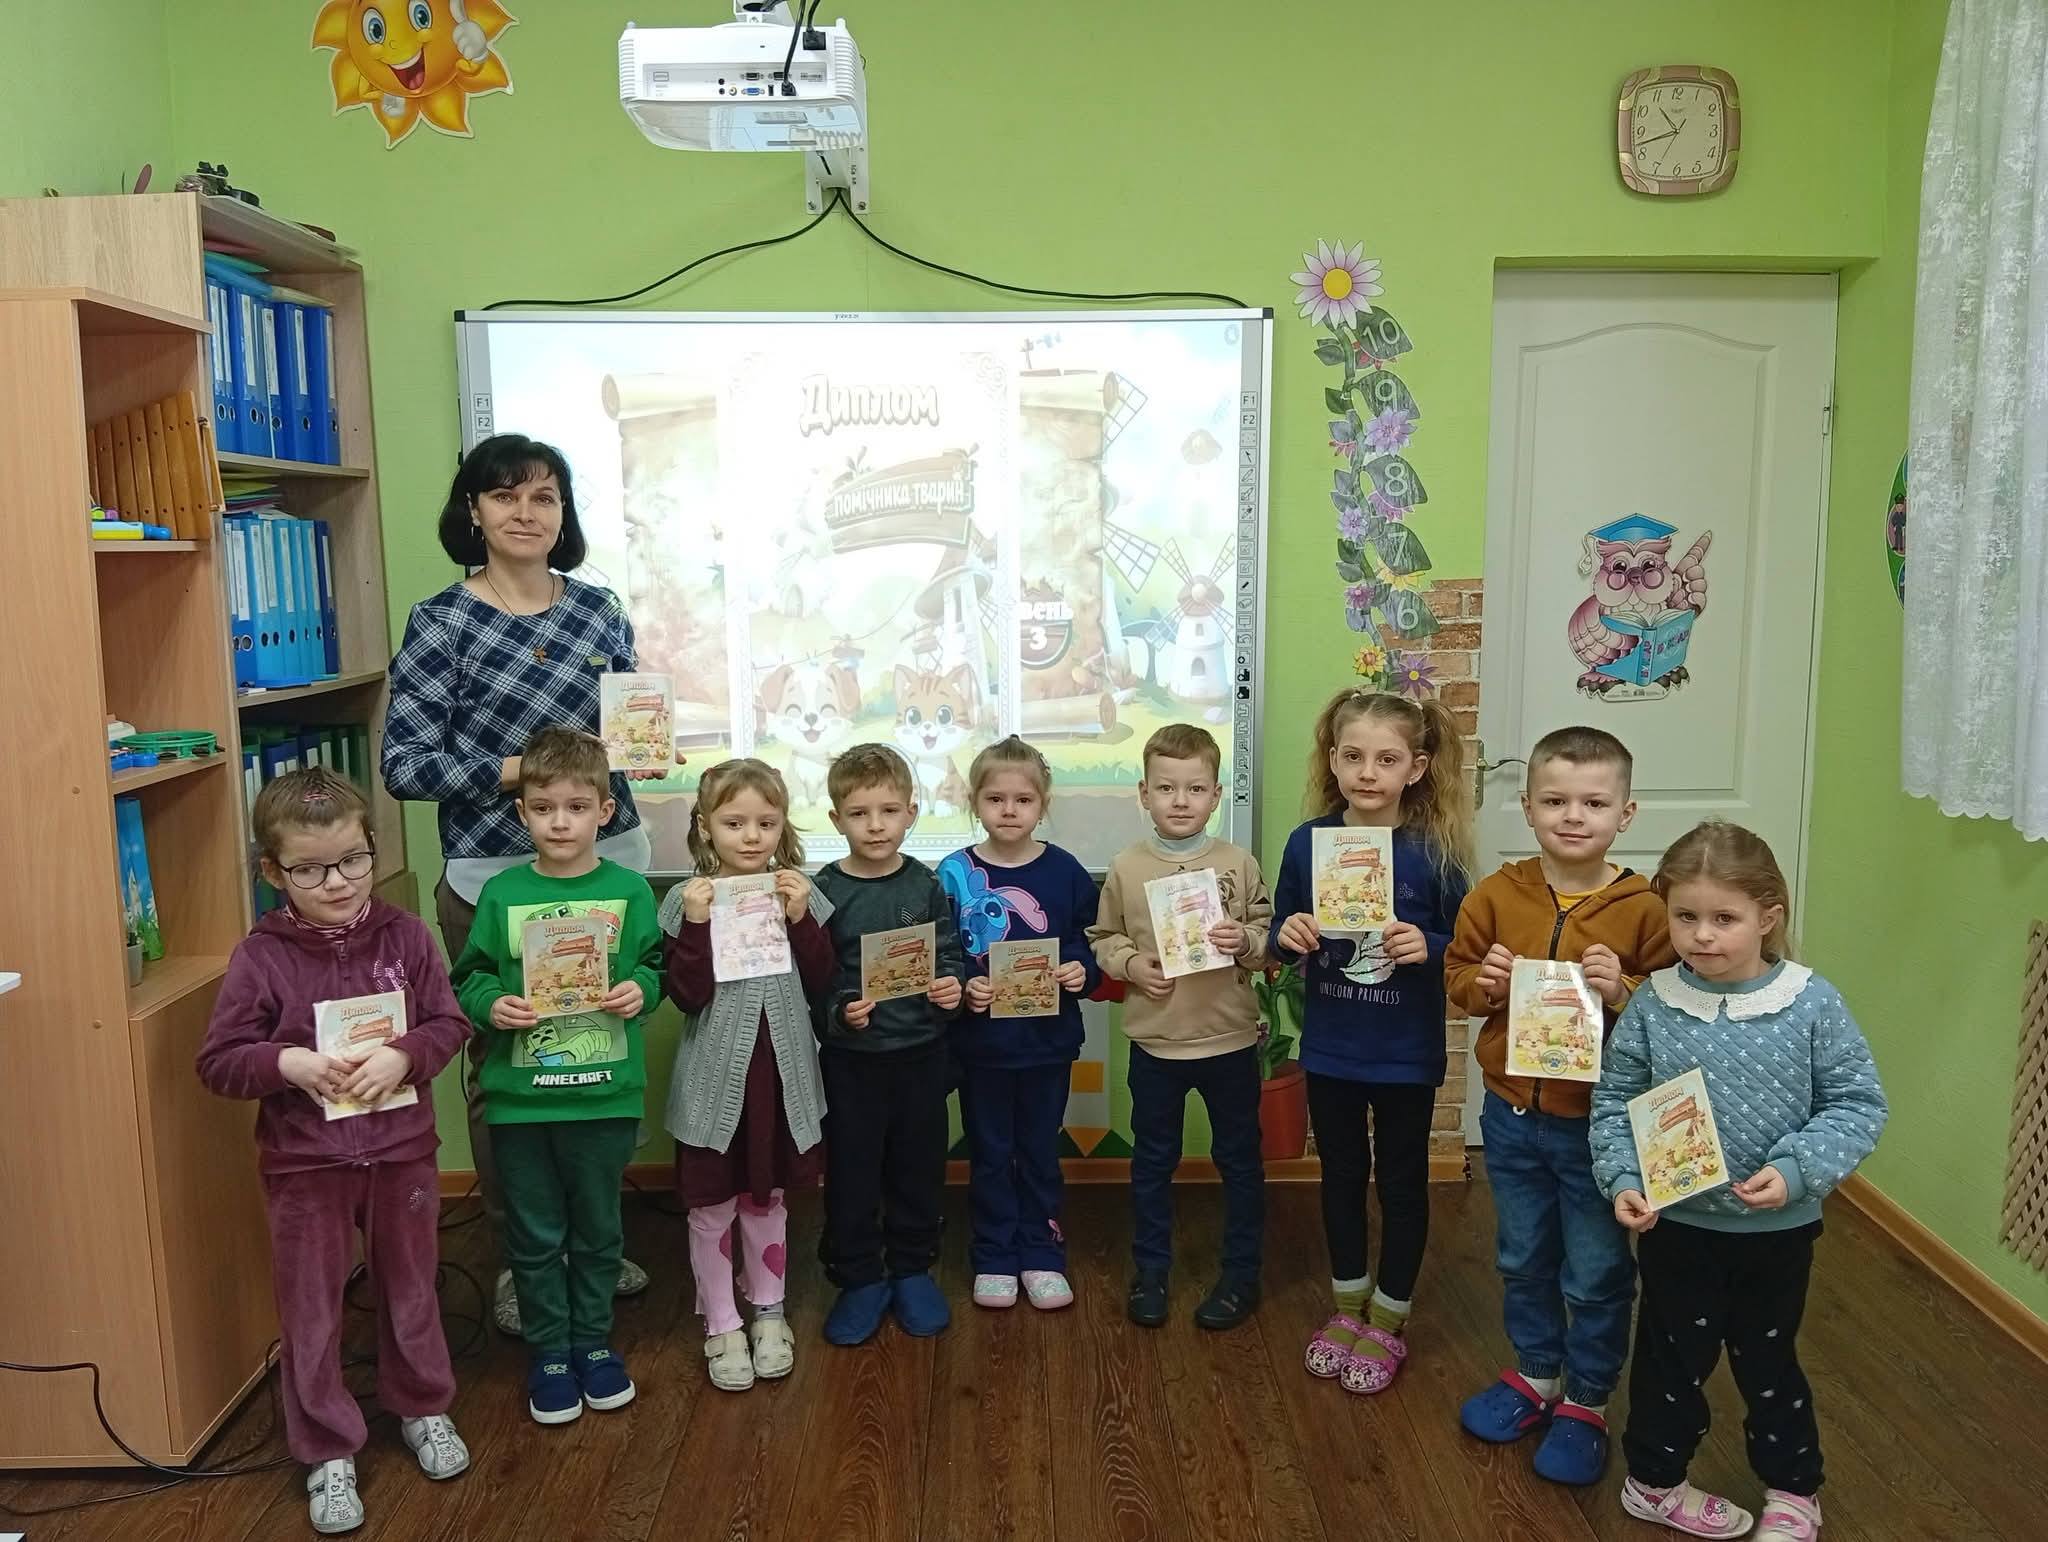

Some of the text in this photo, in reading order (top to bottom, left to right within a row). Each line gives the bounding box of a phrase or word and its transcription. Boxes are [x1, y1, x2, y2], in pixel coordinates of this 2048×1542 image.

[1653, 89, 1662, 102] 11
[1672, 87, 1684, 100] 12
[1638, 104, 1649, 118] 10
[1708, 103, 1717, 117] 2
[1637, 125, 1646, 139] 9
[1709, 124, 1718, 138] 3
[1637, 147, 1647, 160] 8
[1707, 146, 1716, 159] 4
[1652, 161, 1662, 175] 7
[1672, 163, 1682, 176] 6
[1692, 161, 1702, 174] 5
[1361, 317, 1400, 353] 10
[476, 397, 489, 407] F1
[1243, 395, 1255, 405] F1
[1375, 379, 1398, 413] 9
[800, 374, 940, 437] Диплом
[478, 417, 490, 427] F2
[1242, 414, 1256, 425] F2
[1385, 462, 1408, 497] 8
[1387, 531, 1408, 567] 7
[1397, 597, 1419, 630] 6
[1029, 625, 1048, 651] 3
[1319, 981, 1400, 1005] UNICORN PRINCESS
[532, 1069, 613, 1089] MINECRAFT
